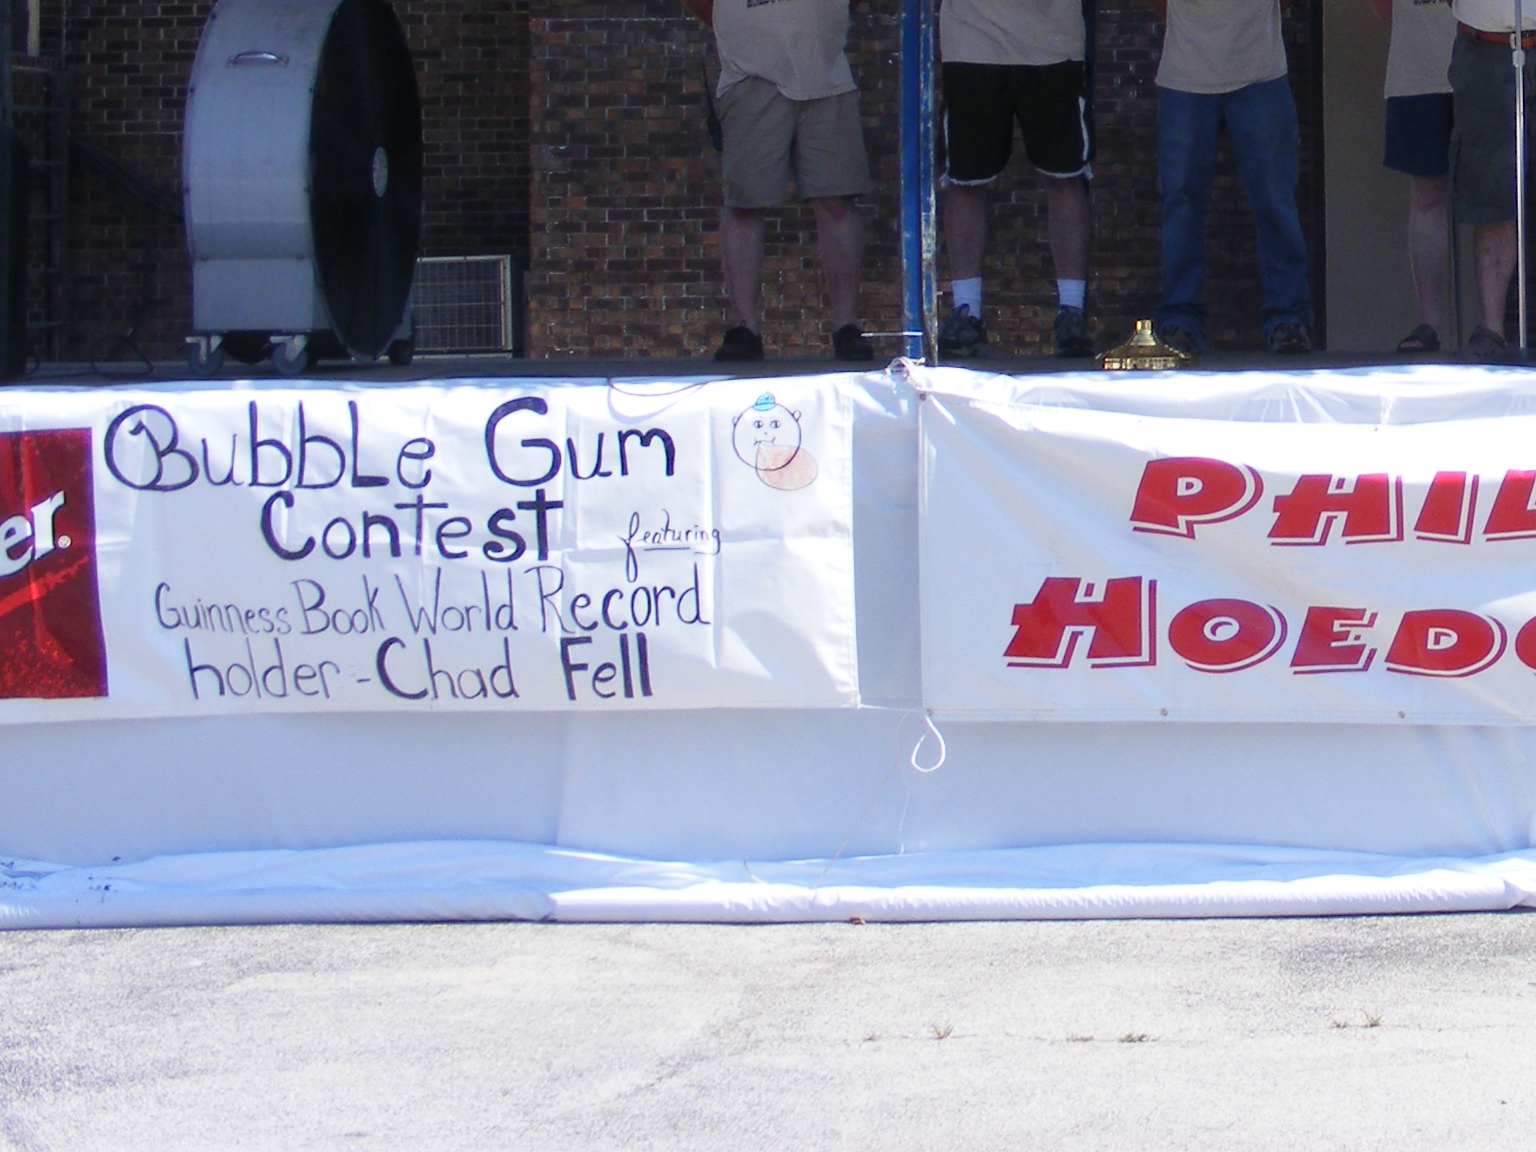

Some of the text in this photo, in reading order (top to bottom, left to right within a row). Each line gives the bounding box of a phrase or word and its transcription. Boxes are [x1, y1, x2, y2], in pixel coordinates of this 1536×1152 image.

[485, 396, 676, 487] Gum
[260, 489, 565, 563] Contest
[619, 510, 723, 584] featuring
[153, 563, 713, 636] Guinness Book World Record
[559, 633, 655, 703] Fell
